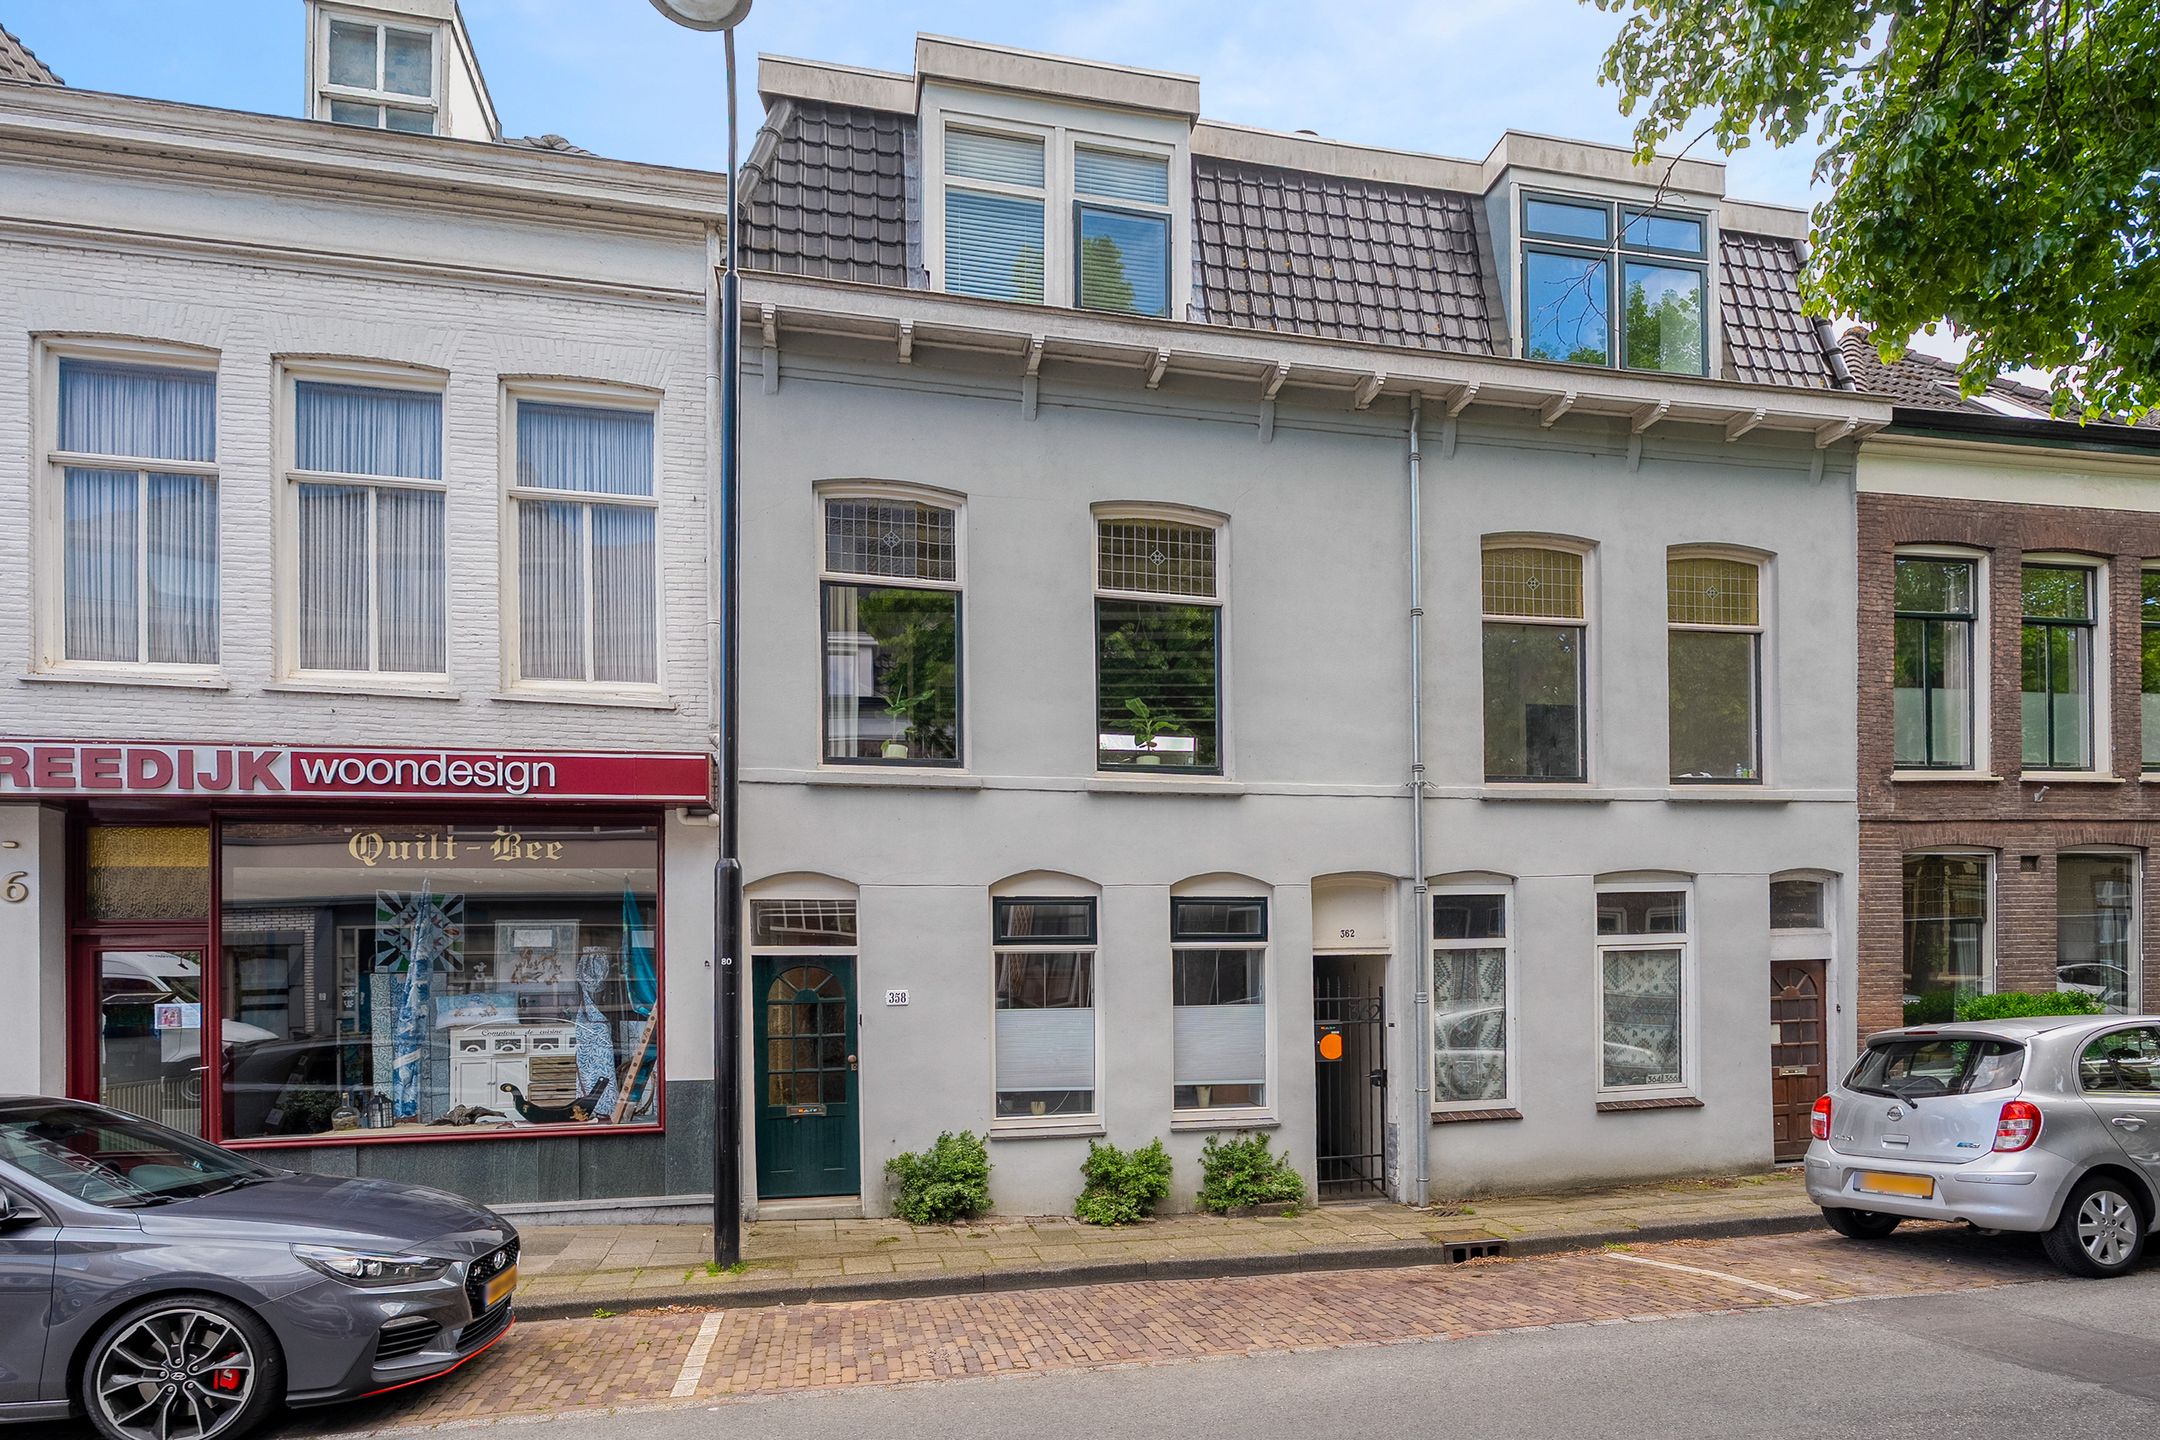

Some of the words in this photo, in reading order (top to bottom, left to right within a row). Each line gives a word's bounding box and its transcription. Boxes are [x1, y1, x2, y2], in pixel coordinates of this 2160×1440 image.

[0, 746, 286, 791] REEDIJK
[300, 753, 556, 795] woondesign
[348, 832, 458, 867] Quilt
[489, 829, 563, 862] Bee
[0, 871, 28, 903] 6
[1340, 929, 1355, 939] 362
[721, 957, 732, 966] 80
[888, 992, 907, 1004] 358
